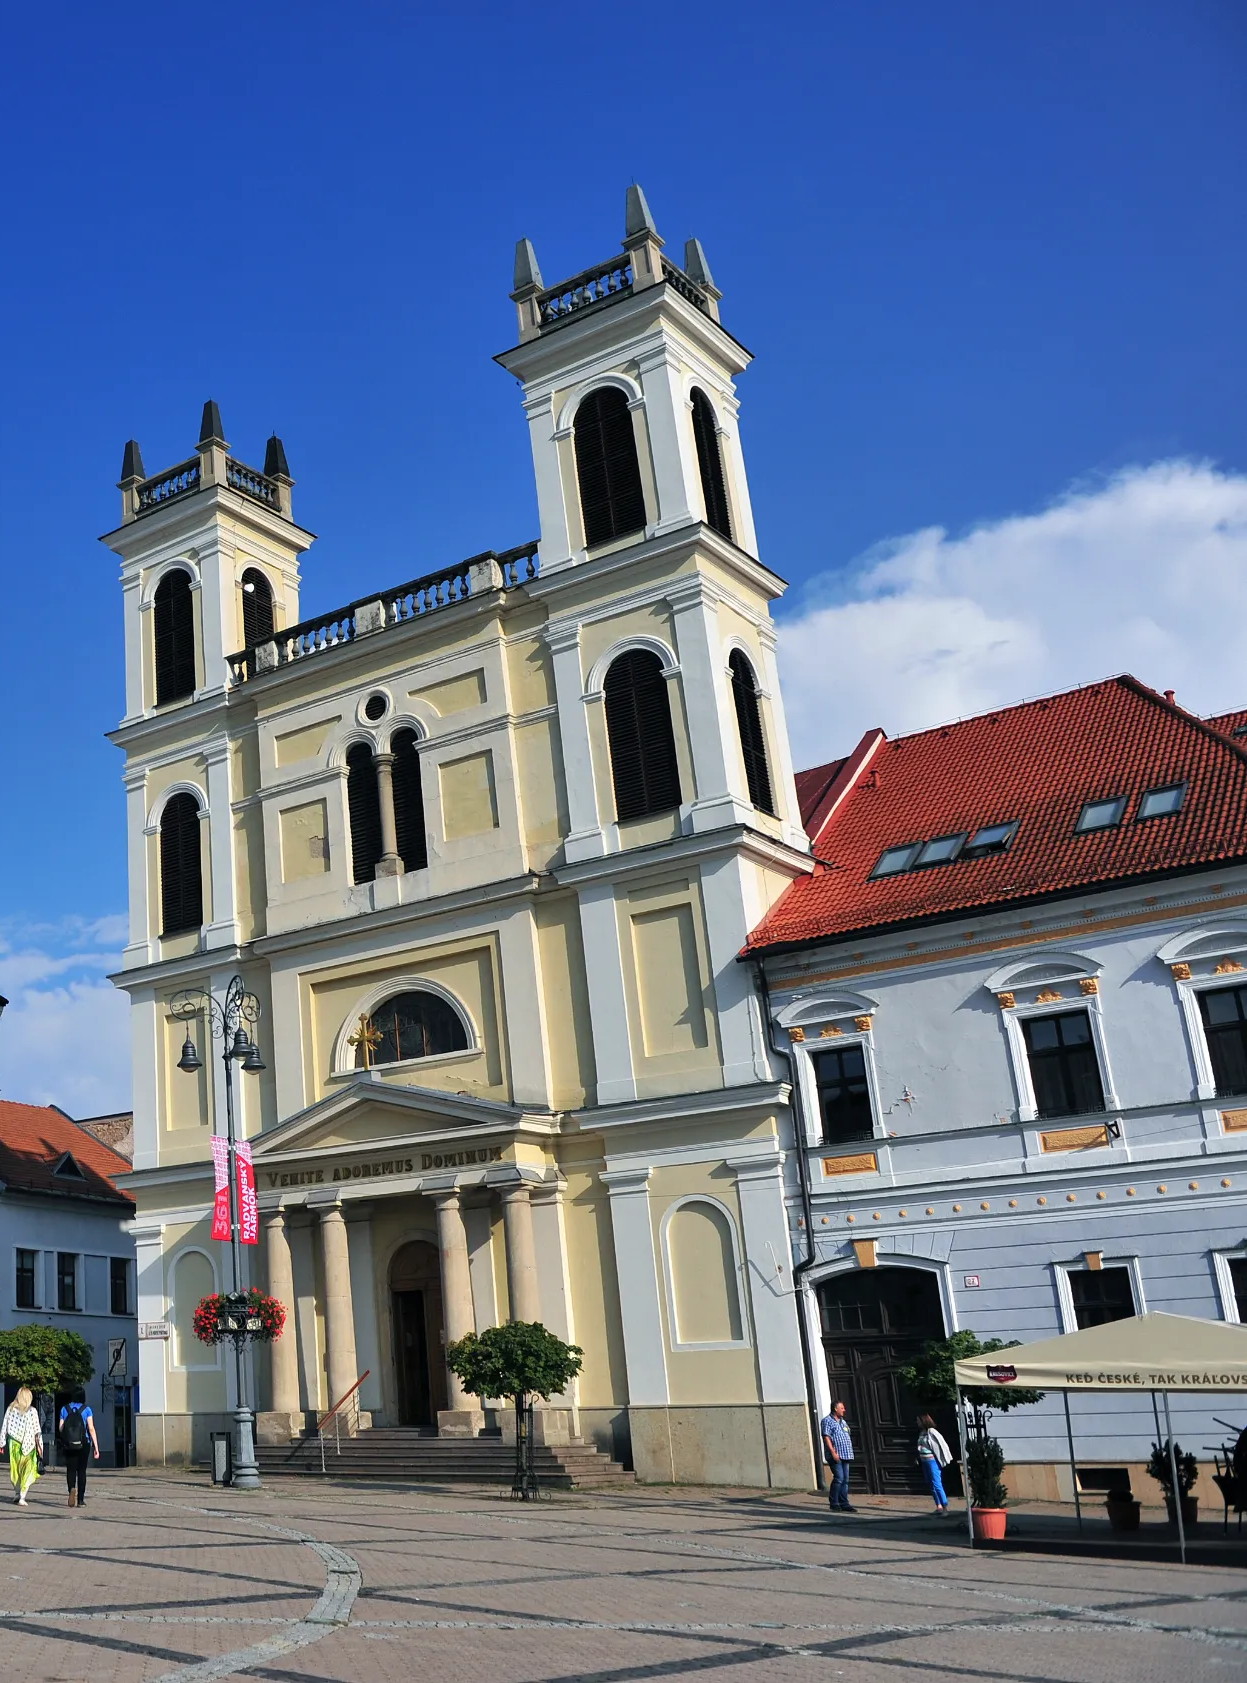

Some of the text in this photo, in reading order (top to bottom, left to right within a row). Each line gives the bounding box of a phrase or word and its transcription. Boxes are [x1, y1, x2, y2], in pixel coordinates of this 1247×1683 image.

[267, 1147, 504, 1187] VENITE ADOREMUS DOMINUM
[238, 1160, 251, 1240] RADVANSKÝ
[248, 1187, 257, 1240] JARMOK
[1066, 1372, 1093, 1384] KEĎ
[1098, 1372, 1145, 1385] ČESKÉ,
[1149, 1374, 1176, 1384] TAK
